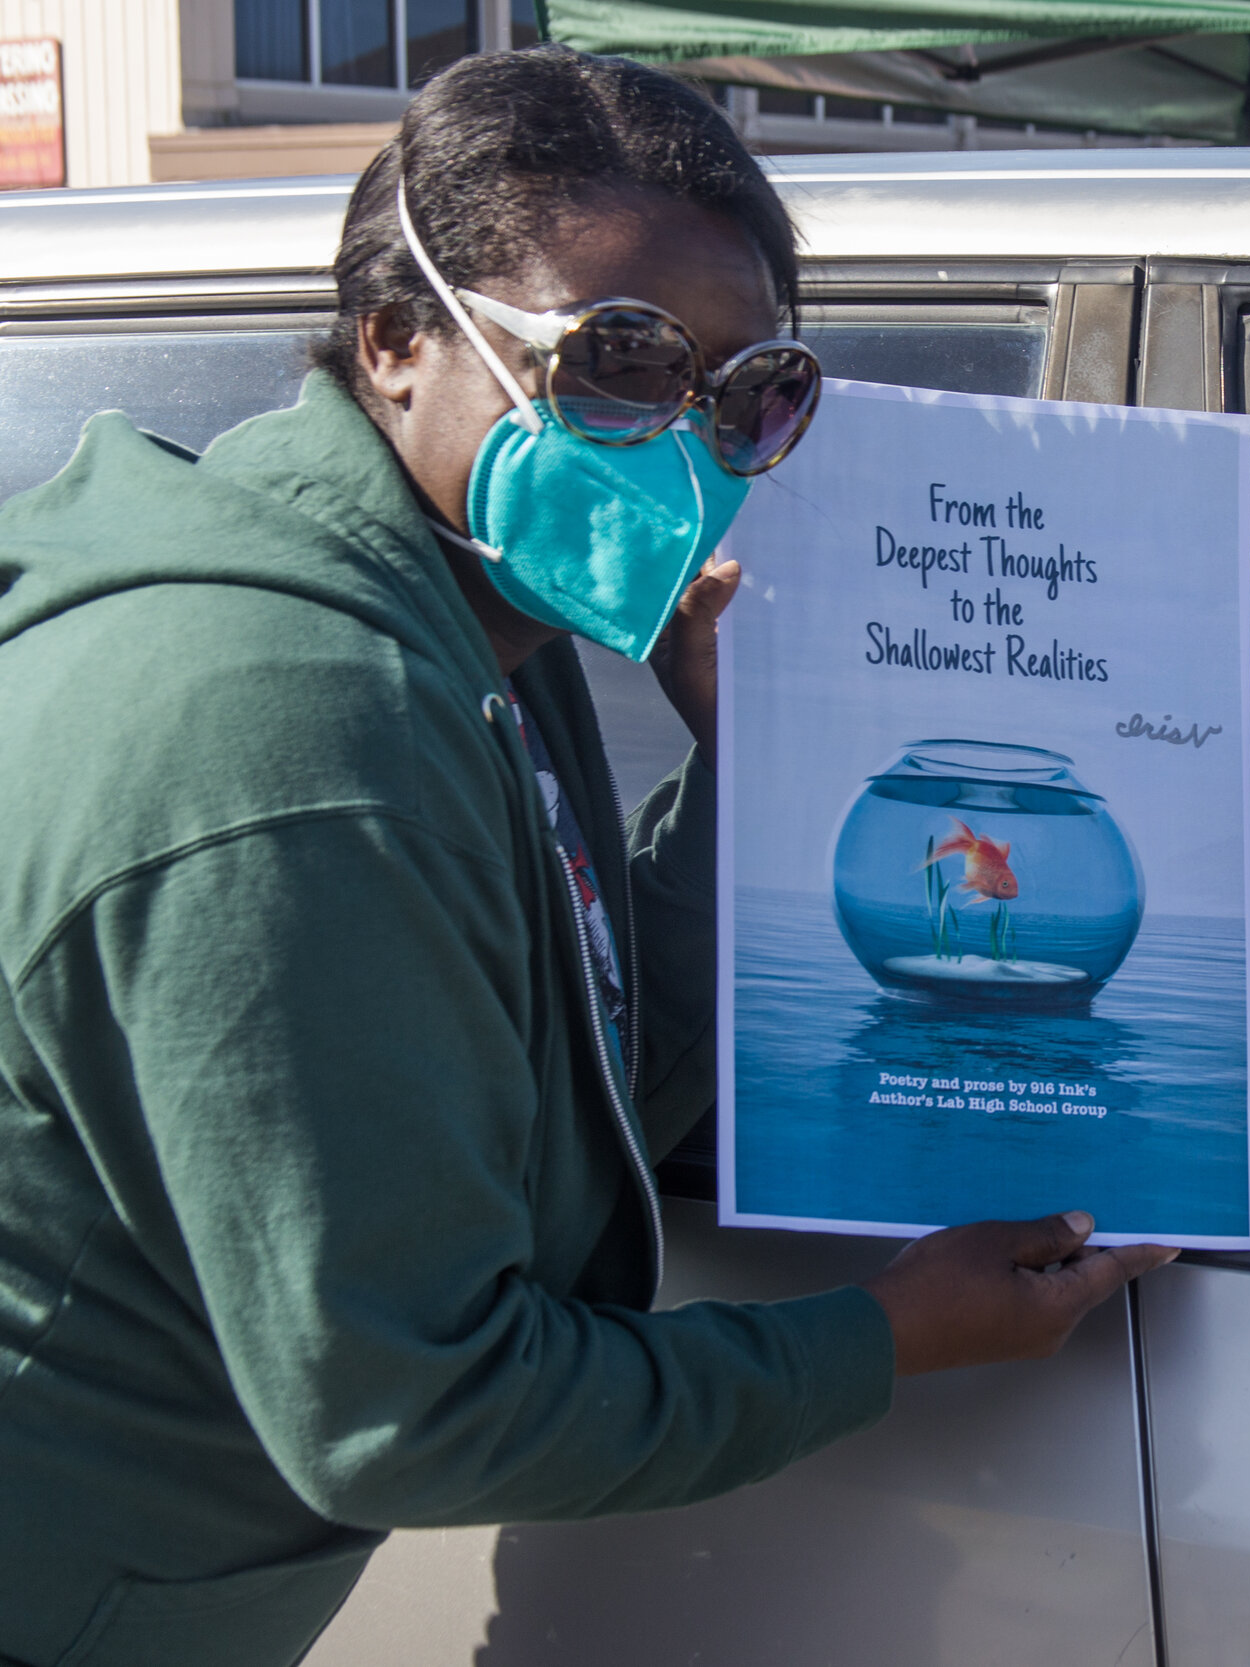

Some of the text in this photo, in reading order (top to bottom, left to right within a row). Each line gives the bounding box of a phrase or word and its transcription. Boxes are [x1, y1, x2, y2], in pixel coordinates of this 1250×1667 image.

[930, 483, 1045, 530] From the
[876, 526, 1098, 600] Deepest Thoughts
[950, 587, 1024, 626] to the
[866, 622, 1109, 682] Shallowest Realities
[869, 1091, 1108, 1118] Author's Lab High School Group
[879, 1072, 1096, 1097] Poetry and prose by 916 Ink's
